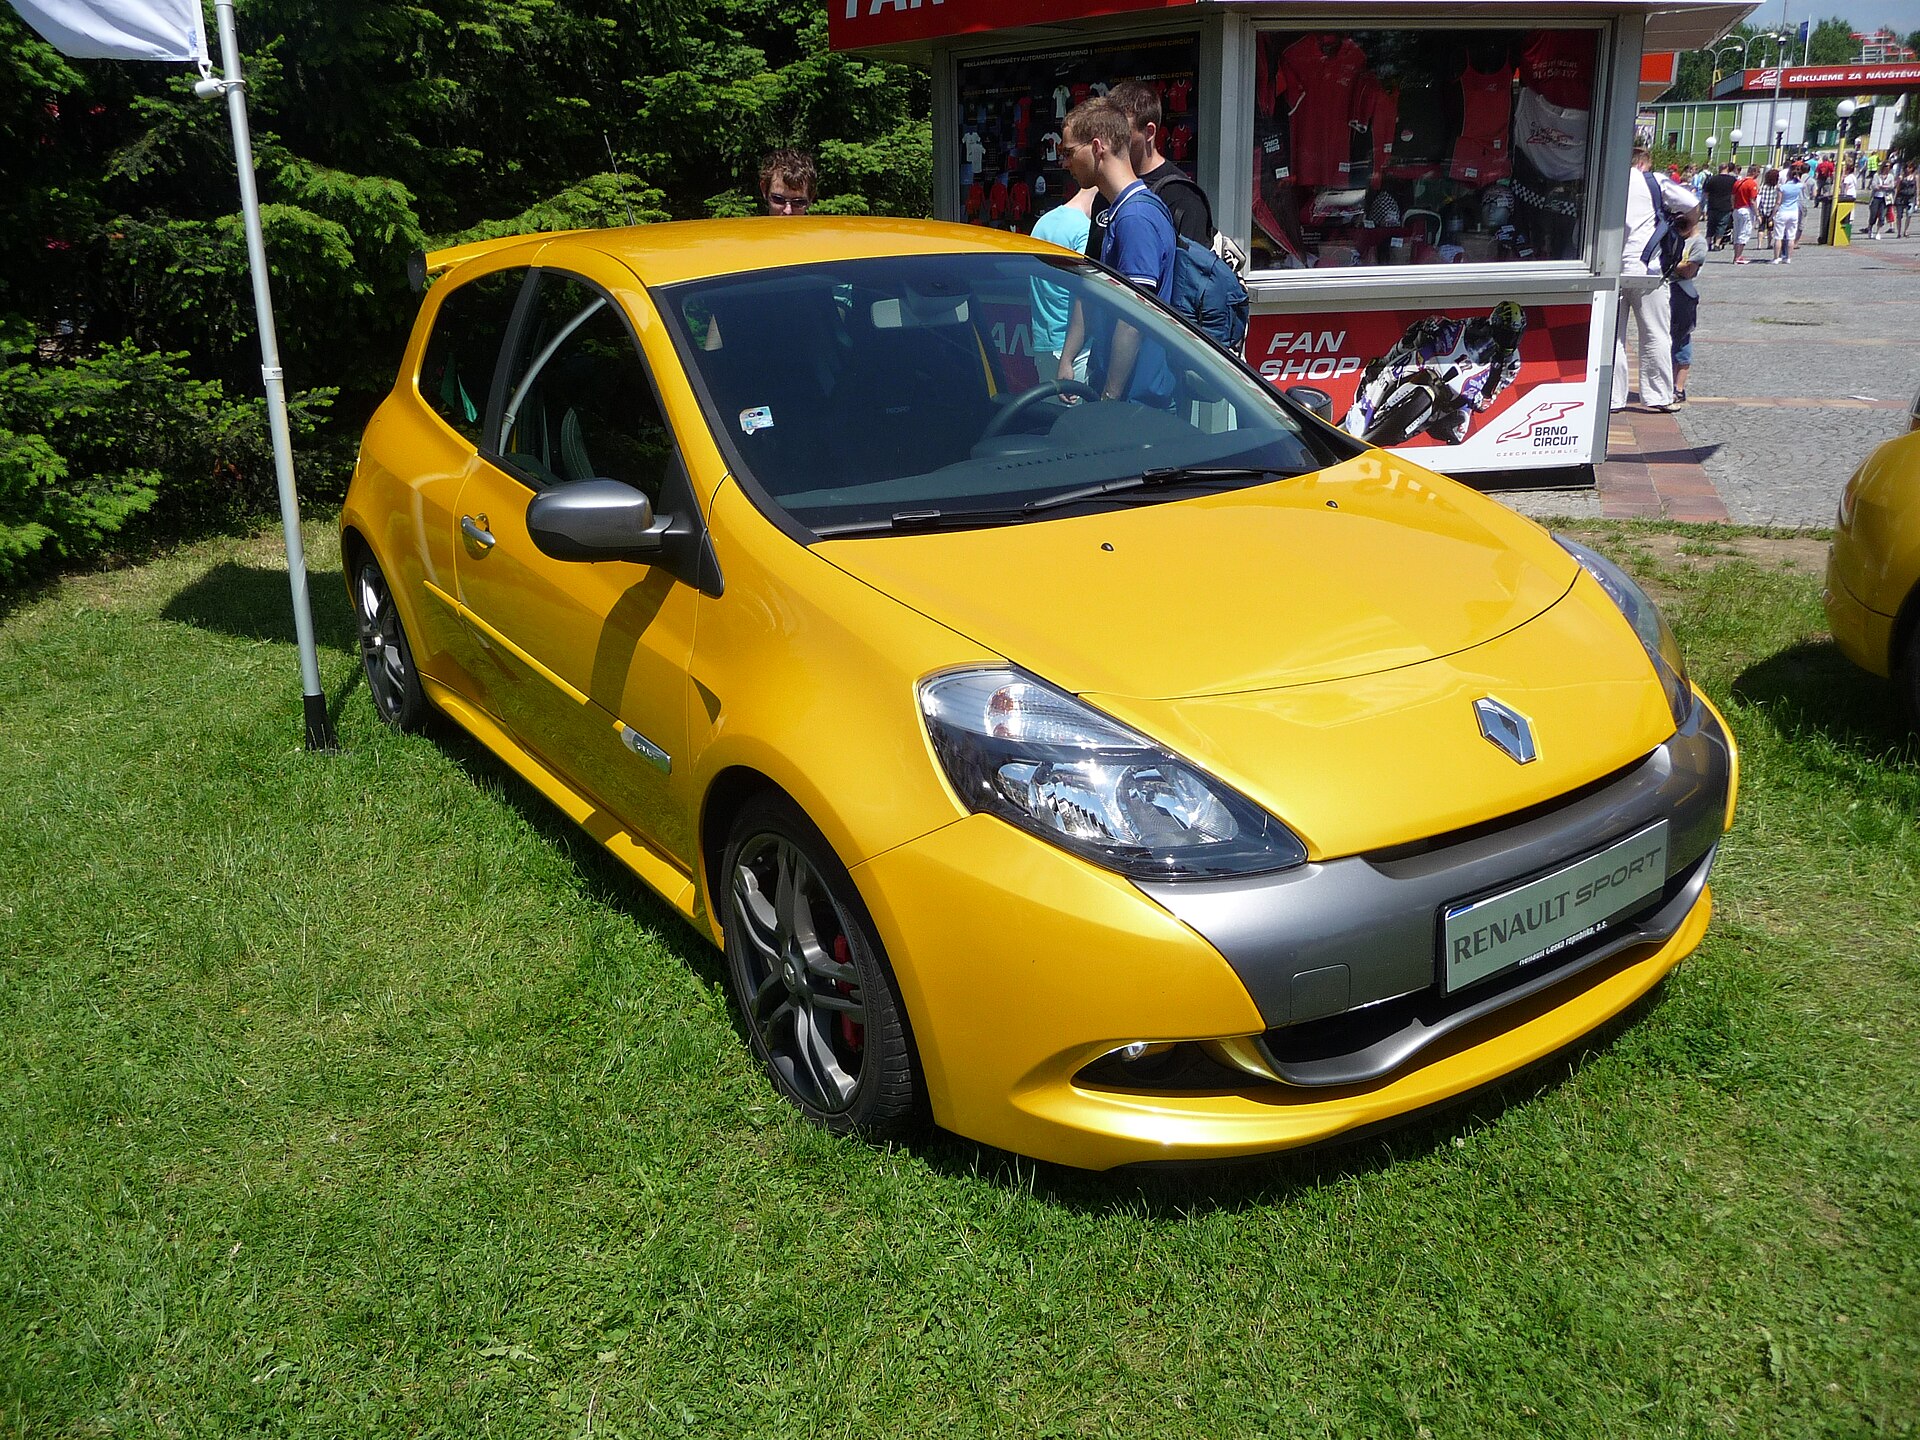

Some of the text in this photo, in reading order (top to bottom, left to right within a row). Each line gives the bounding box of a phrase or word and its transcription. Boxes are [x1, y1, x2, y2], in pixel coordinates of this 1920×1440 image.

[1848, 73, 1862, 81] ZA
[1266, 330, 1347, 355] FAN
[1259, 357, 1361, 382] SHOP
[1534, 425, 1569, 437] BRNO
[1533, 435, 1579, 447] CIRCUIT
[1531, 448, 1579, 456] REPUBLIC
[1453, 846, 1662, 965] RENAULT SPORT
